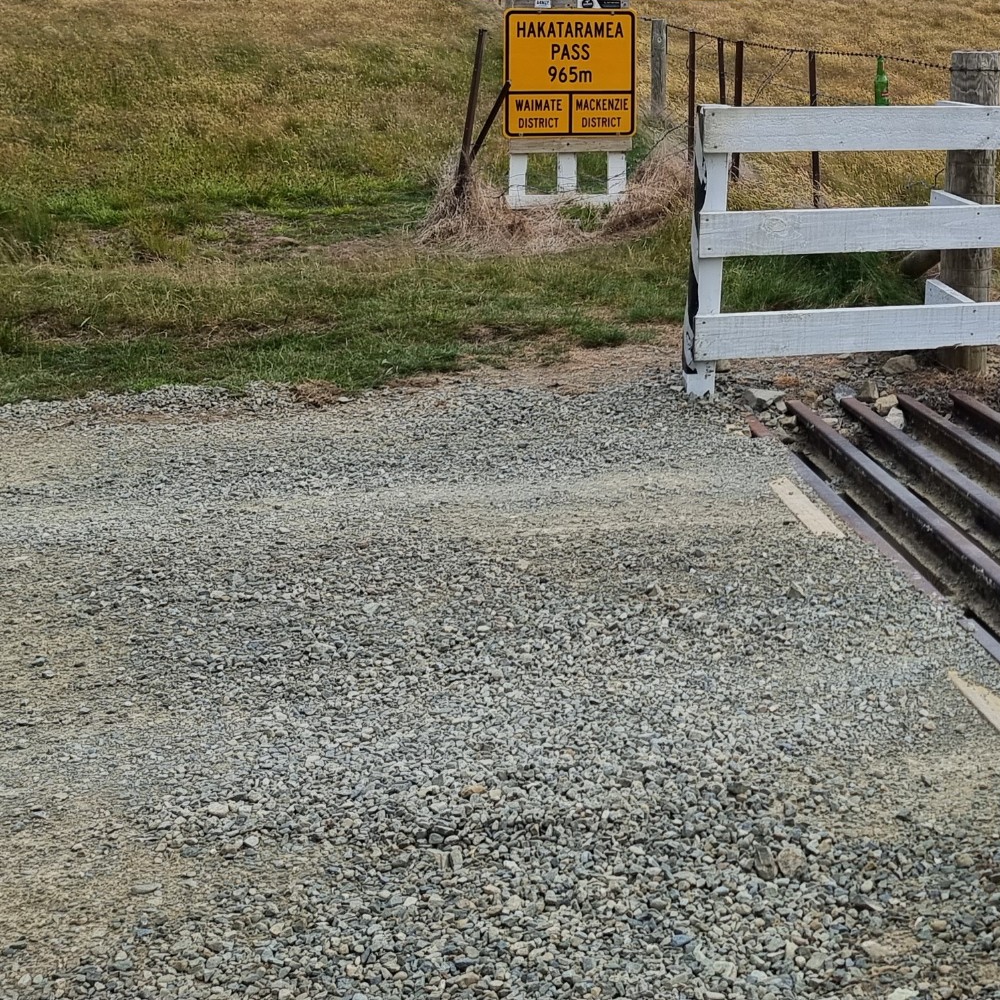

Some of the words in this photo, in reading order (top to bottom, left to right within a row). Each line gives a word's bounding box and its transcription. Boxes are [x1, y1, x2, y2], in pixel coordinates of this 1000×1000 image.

[516, 21, 624, 39] HAKATARAMEA
[551, 44, 590, 60] PASS
[548, 66, 592, 83] 965m
[515, 99, 563, 112] WAIMATE
[575, 98, 629, 111] MACKENZIE
[518, 117, 560, 129] DISTRICT
[581, 117, 622, 128] DISTRICT
